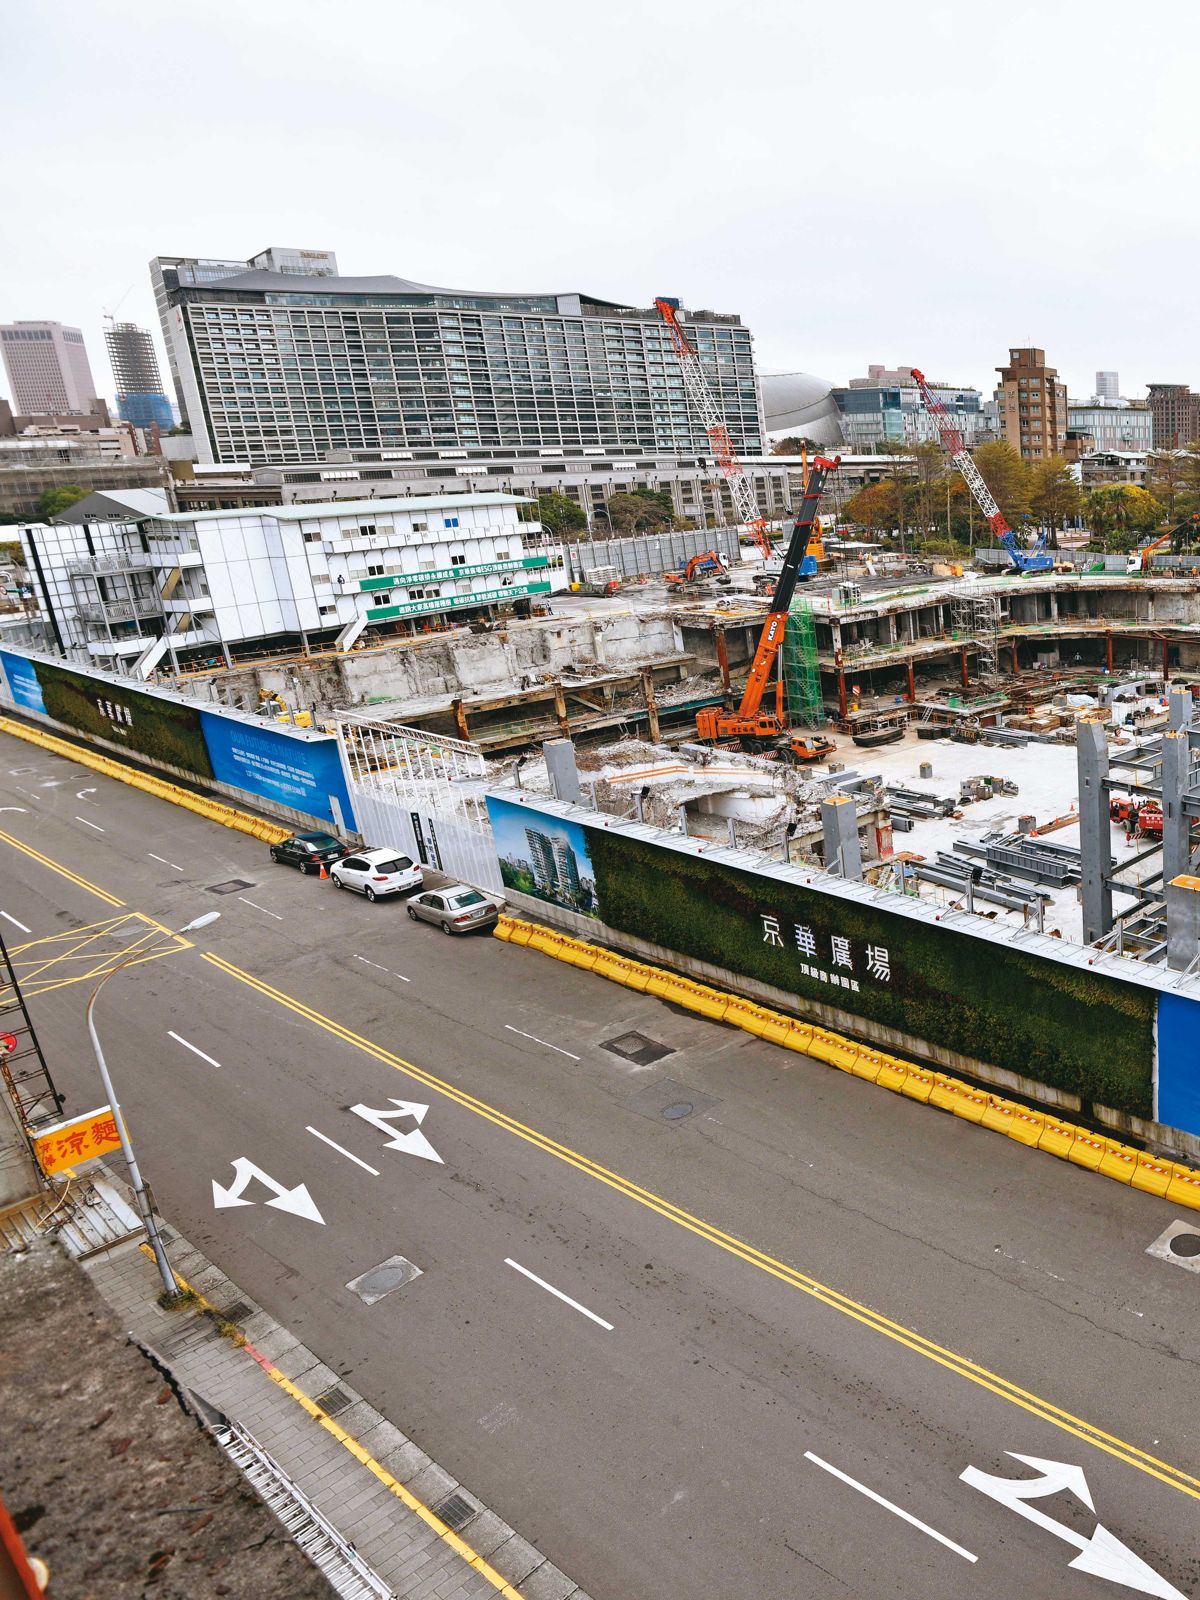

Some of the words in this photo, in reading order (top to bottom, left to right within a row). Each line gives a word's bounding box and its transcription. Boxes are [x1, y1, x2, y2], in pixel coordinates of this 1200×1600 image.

[767, 621, 778, 641] KATO
[760, 913, 891, 982] 京華廣場
[56, 1120, 121, 1158] 涼麵
